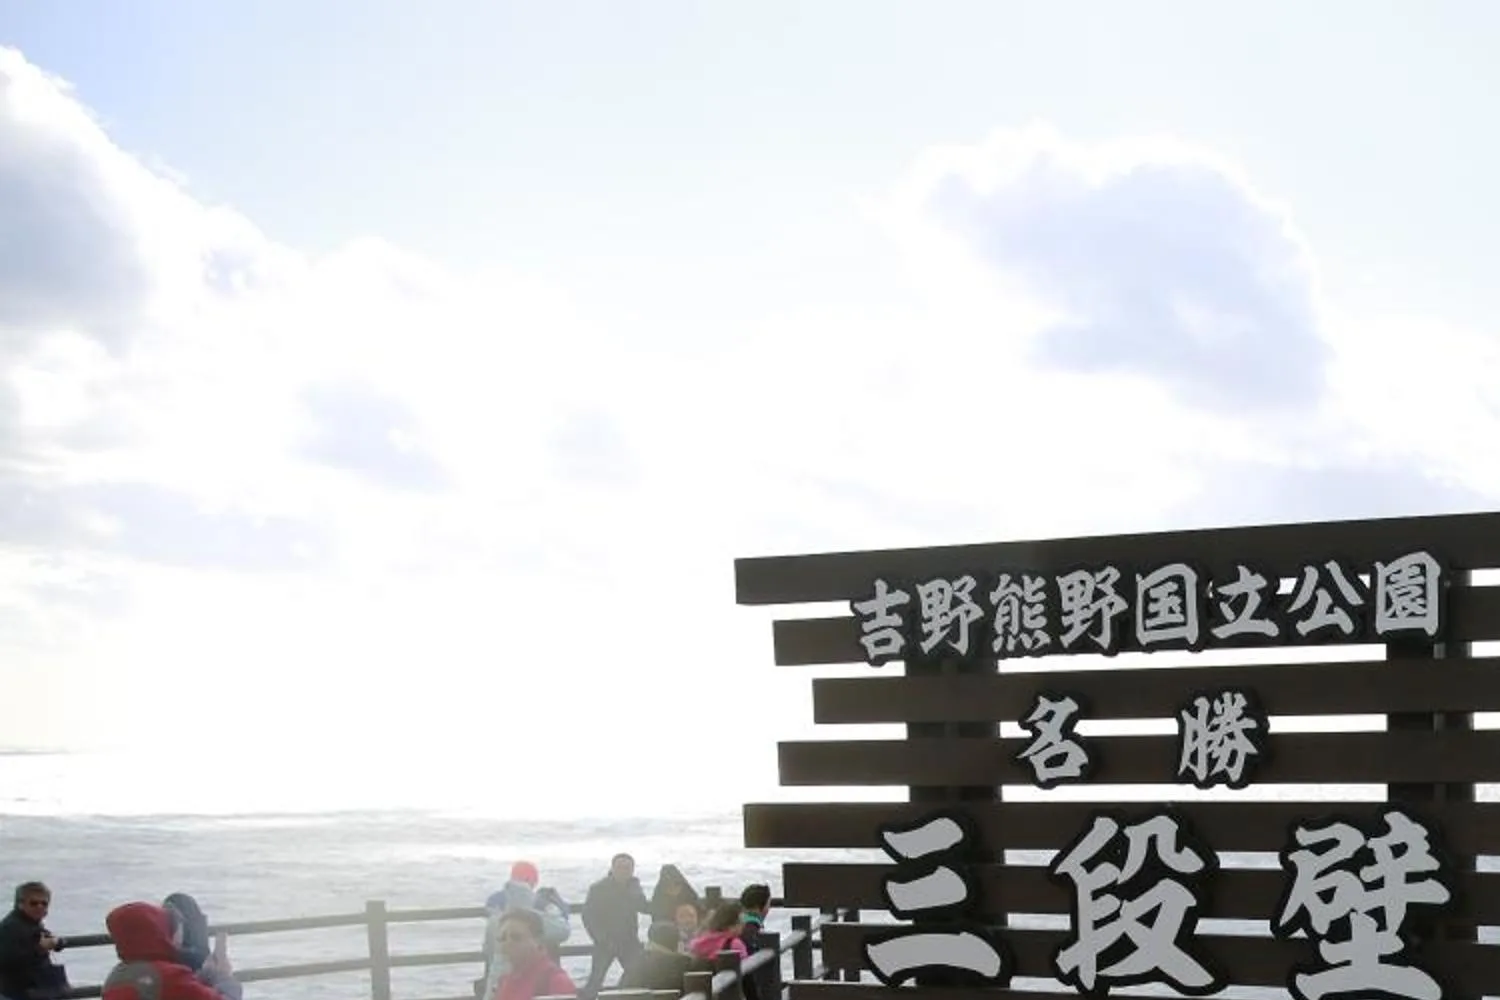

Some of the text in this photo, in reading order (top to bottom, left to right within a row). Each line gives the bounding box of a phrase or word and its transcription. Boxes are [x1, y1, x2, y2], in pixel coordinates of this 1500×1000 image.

[852, 552, 1440, 657] 吉野熊野国立公園
[1018, 694, 1259, 783] 名勝
